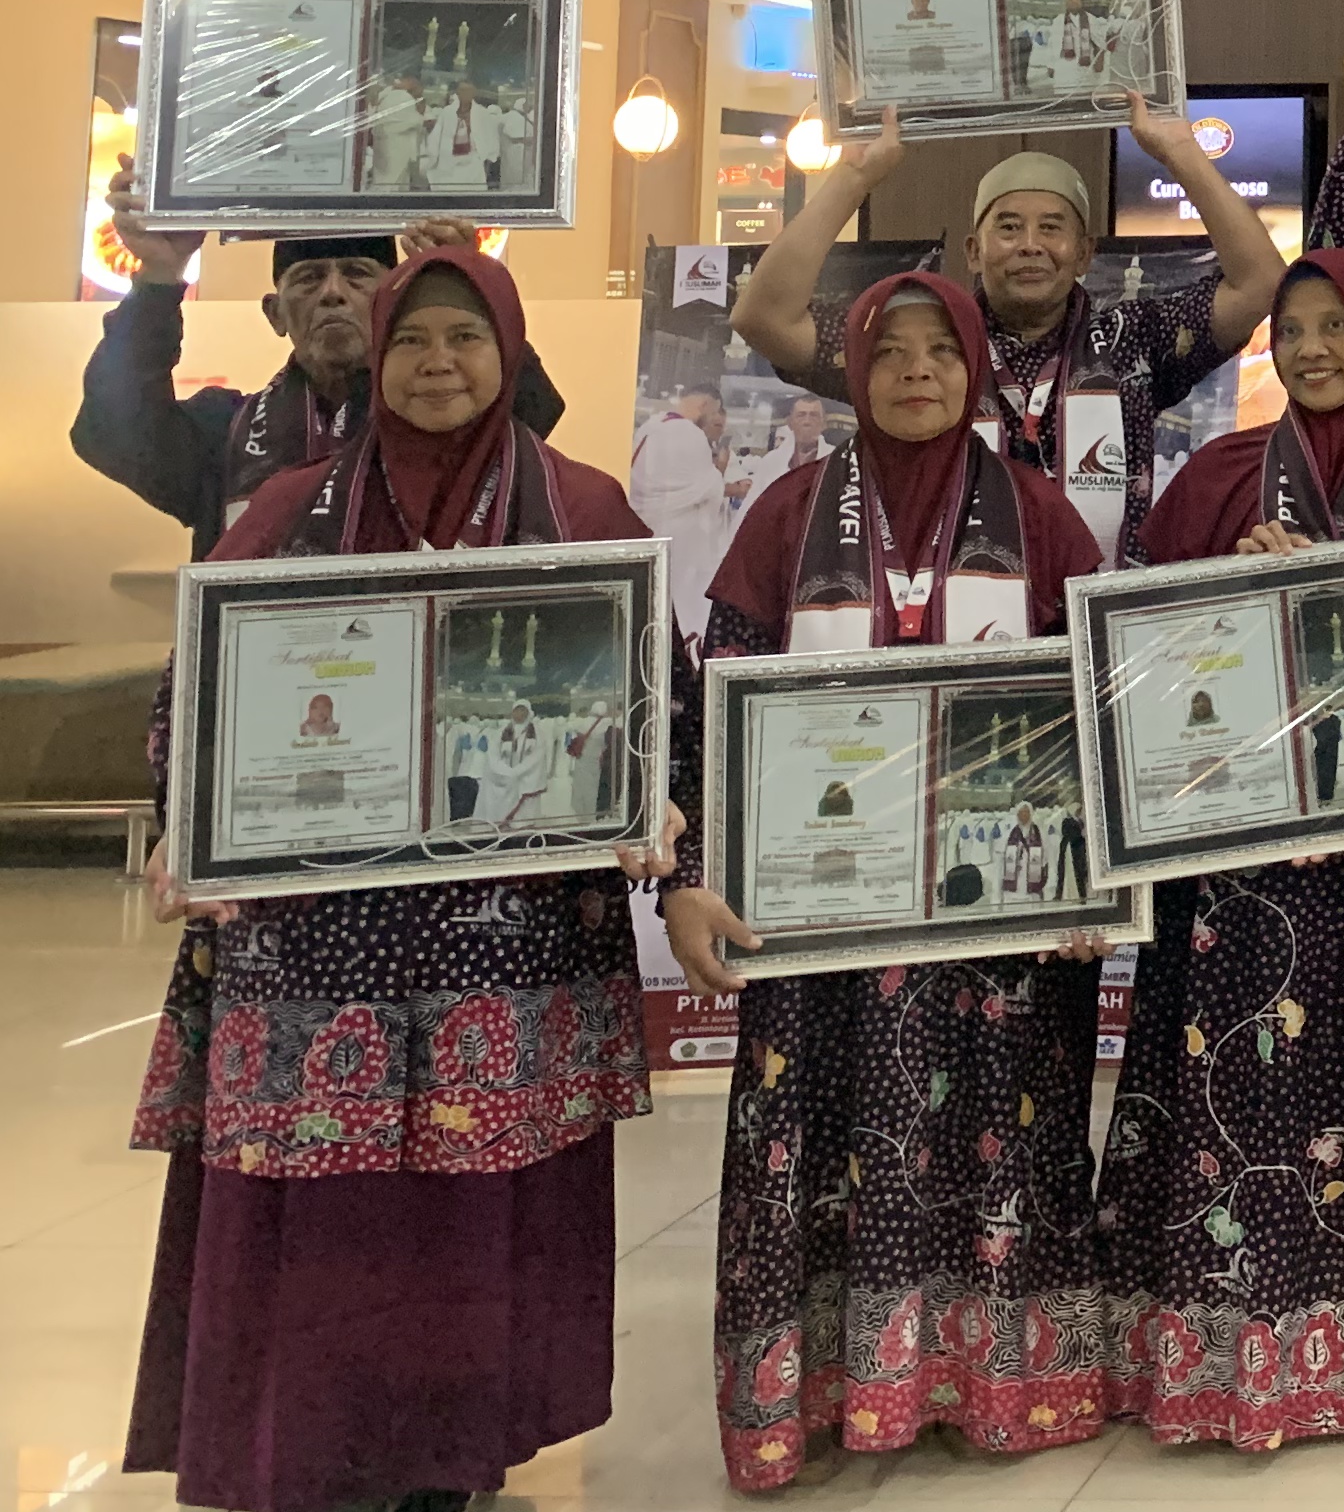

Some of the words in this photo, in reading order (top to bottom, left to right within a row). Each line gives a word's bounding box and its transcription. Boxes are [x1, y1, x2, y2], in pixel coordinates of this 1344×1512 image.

[735, 219, 765, 228] COFFEE
[1100, 972, 1131, 981] EMBER
[677, 995, 709, 1013] PT.
